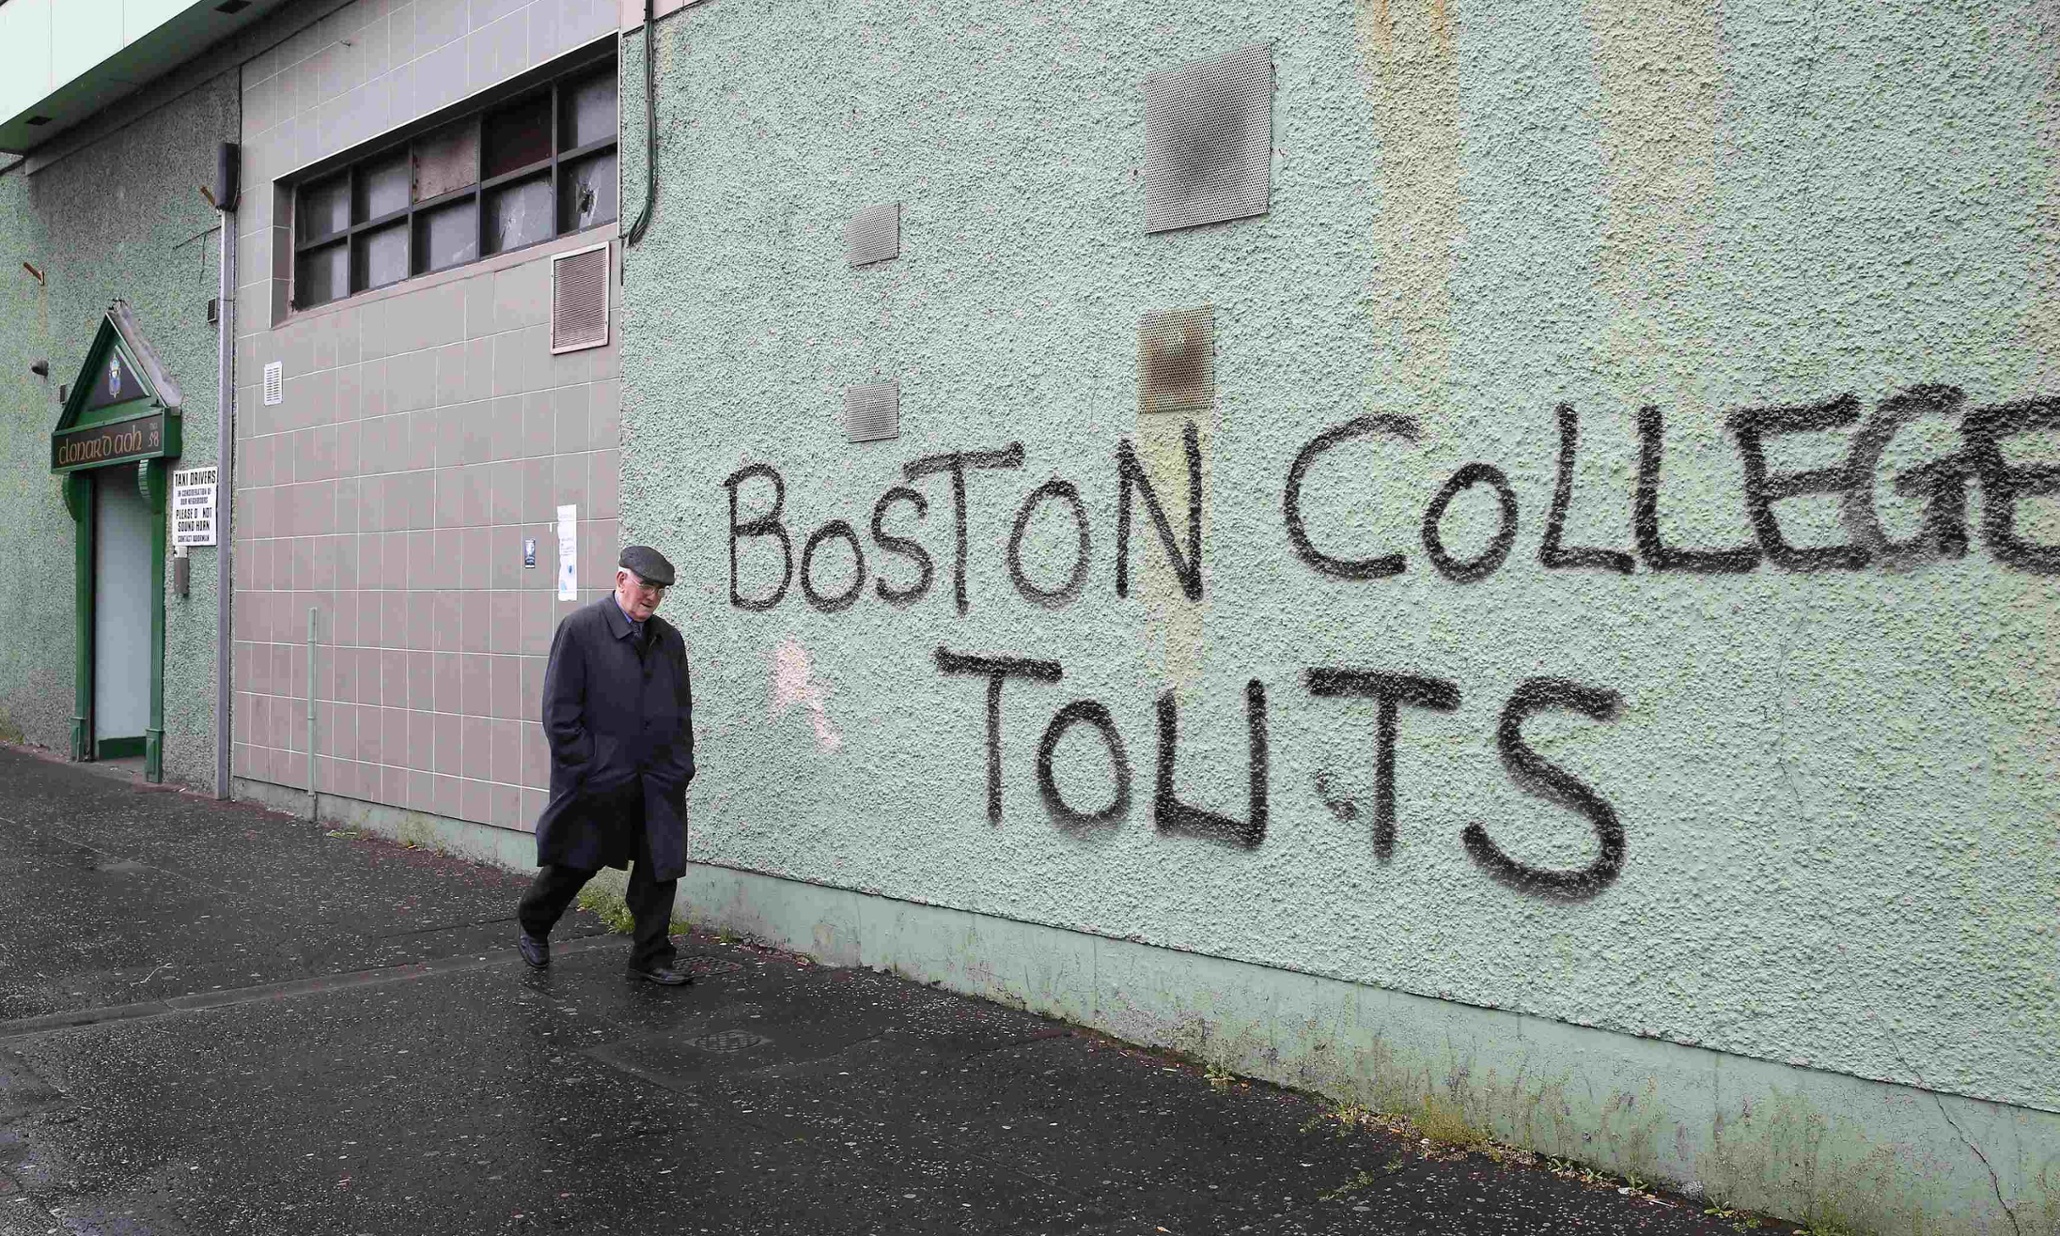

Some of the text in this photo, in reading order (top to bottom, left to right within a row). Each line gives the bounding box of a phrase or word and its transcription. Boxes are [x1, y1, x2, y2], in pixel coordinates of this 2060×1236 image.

[175, 470, 216, 487] TAXI DRIVERS
[176, 508, 193, 520] PLEASE
[202, 507, 213, 519] NOT
[177, 520, 210, 532] SOUND HORN
[934, 645, 1626, 901] TOUTS
